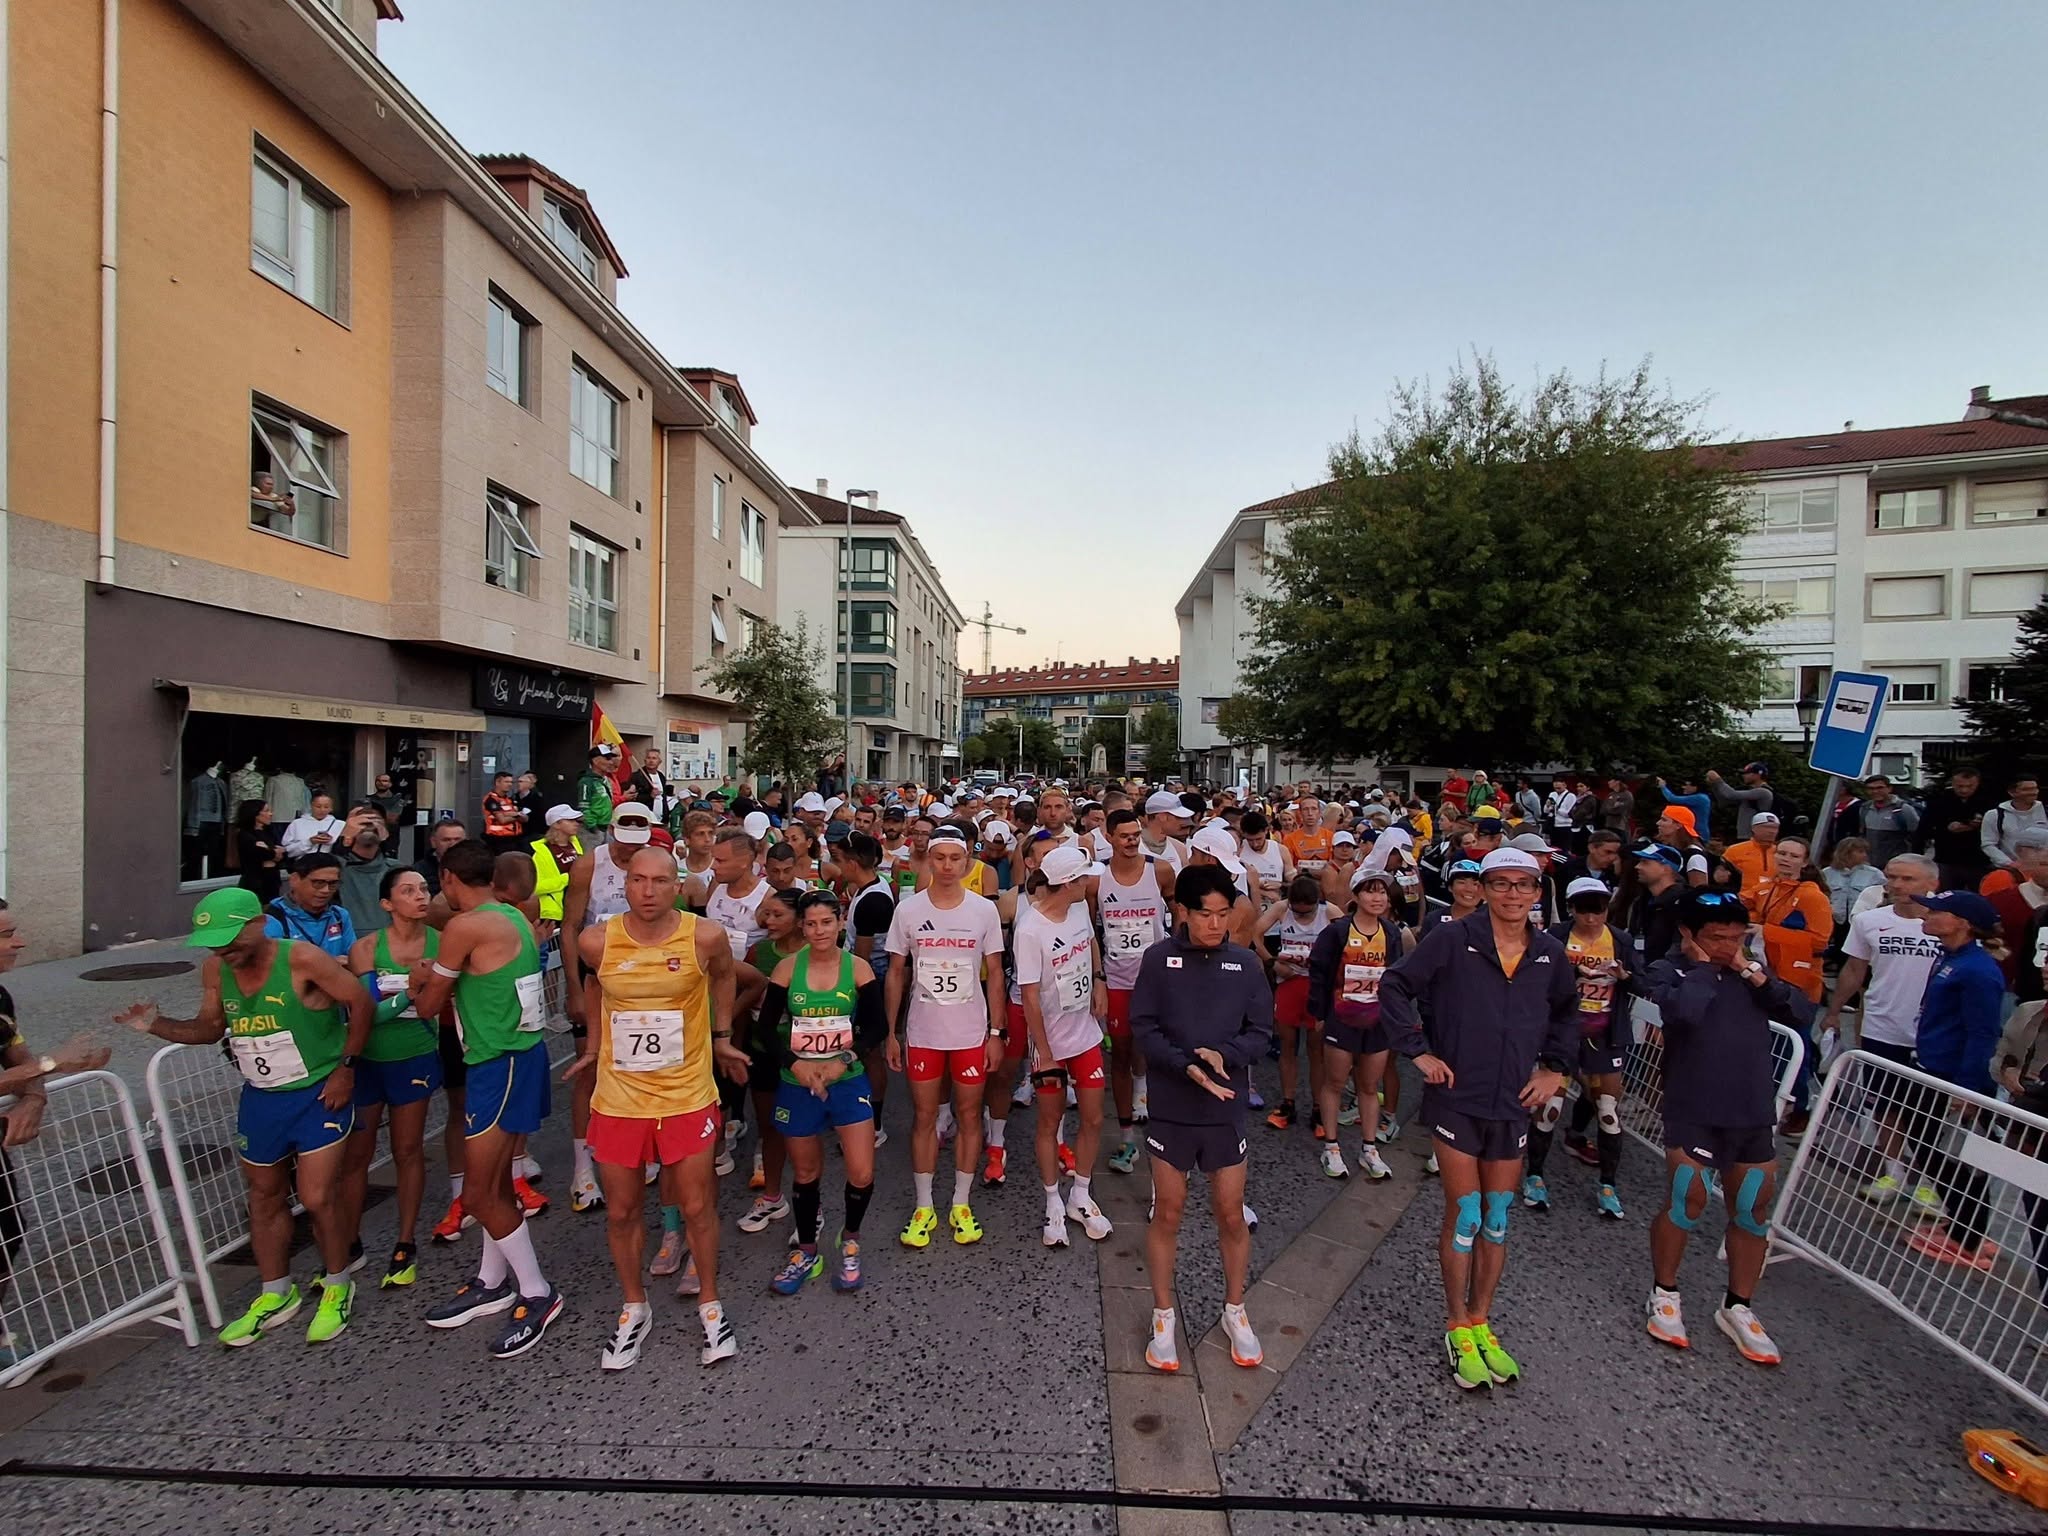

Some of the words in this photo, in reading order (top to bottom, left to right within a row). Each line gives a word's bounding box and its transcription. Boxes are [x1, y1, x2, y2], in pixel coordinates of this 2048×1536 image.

[291, 702, 301, 715] EL
[327, 706, 353, 719] MUNDO
[377, 711, 386, 722] DE
[1105, 907, 1157, 919] FRANCE
[916, 937, 977, 949] FRANCE
[1120, 933, 1142, 949] 36
[1879, 936, 1942, 948] GREAT
[1221, 962, 1243, 972] HOKA
[933, 975, 958, 993] 35
[1072, 975, 1090, 998] 39
[232, 1015, 282, 1033] BRASIL
[628, 1033, 662, 1056] 78
[800, 1033, 844, 1054] 204
[254, 1056, 272, 1076] 8
[504, 1325, 533, 1349] FILA
